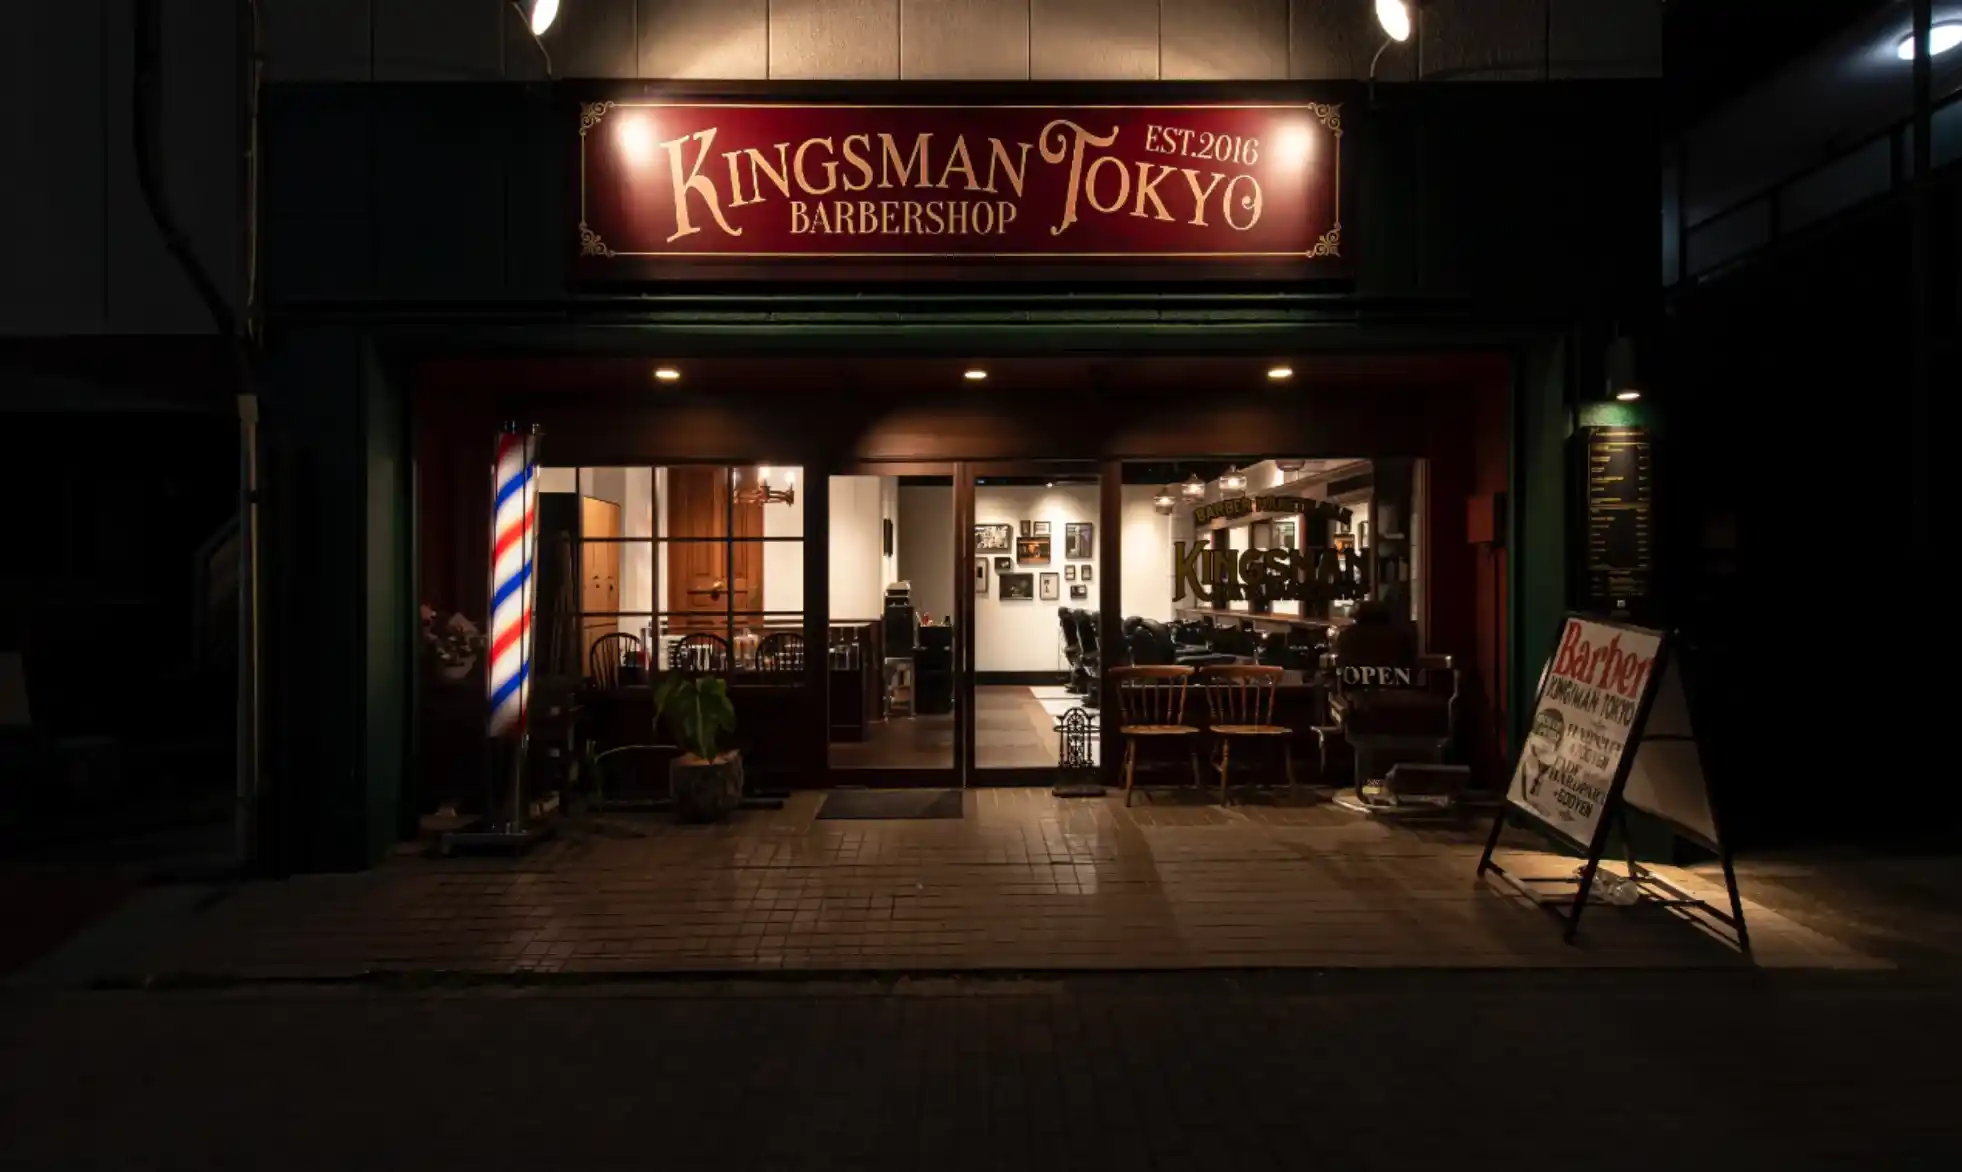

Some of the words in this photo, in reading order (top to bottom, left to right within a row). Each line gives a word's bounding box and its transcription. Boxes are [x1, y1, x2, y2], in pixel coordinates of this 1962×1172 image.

[1145, 124, 1259, 166] EST.2016
[659, 127, 1033, 243] KINGSMAN
[1039, 119, 1263, 236] TOKYO
[789, 200, 1017, 236] BARBERSHOP
[1343, 665, 1412, 685] OPEN
[1552, 622, 1654, 699] Barber
